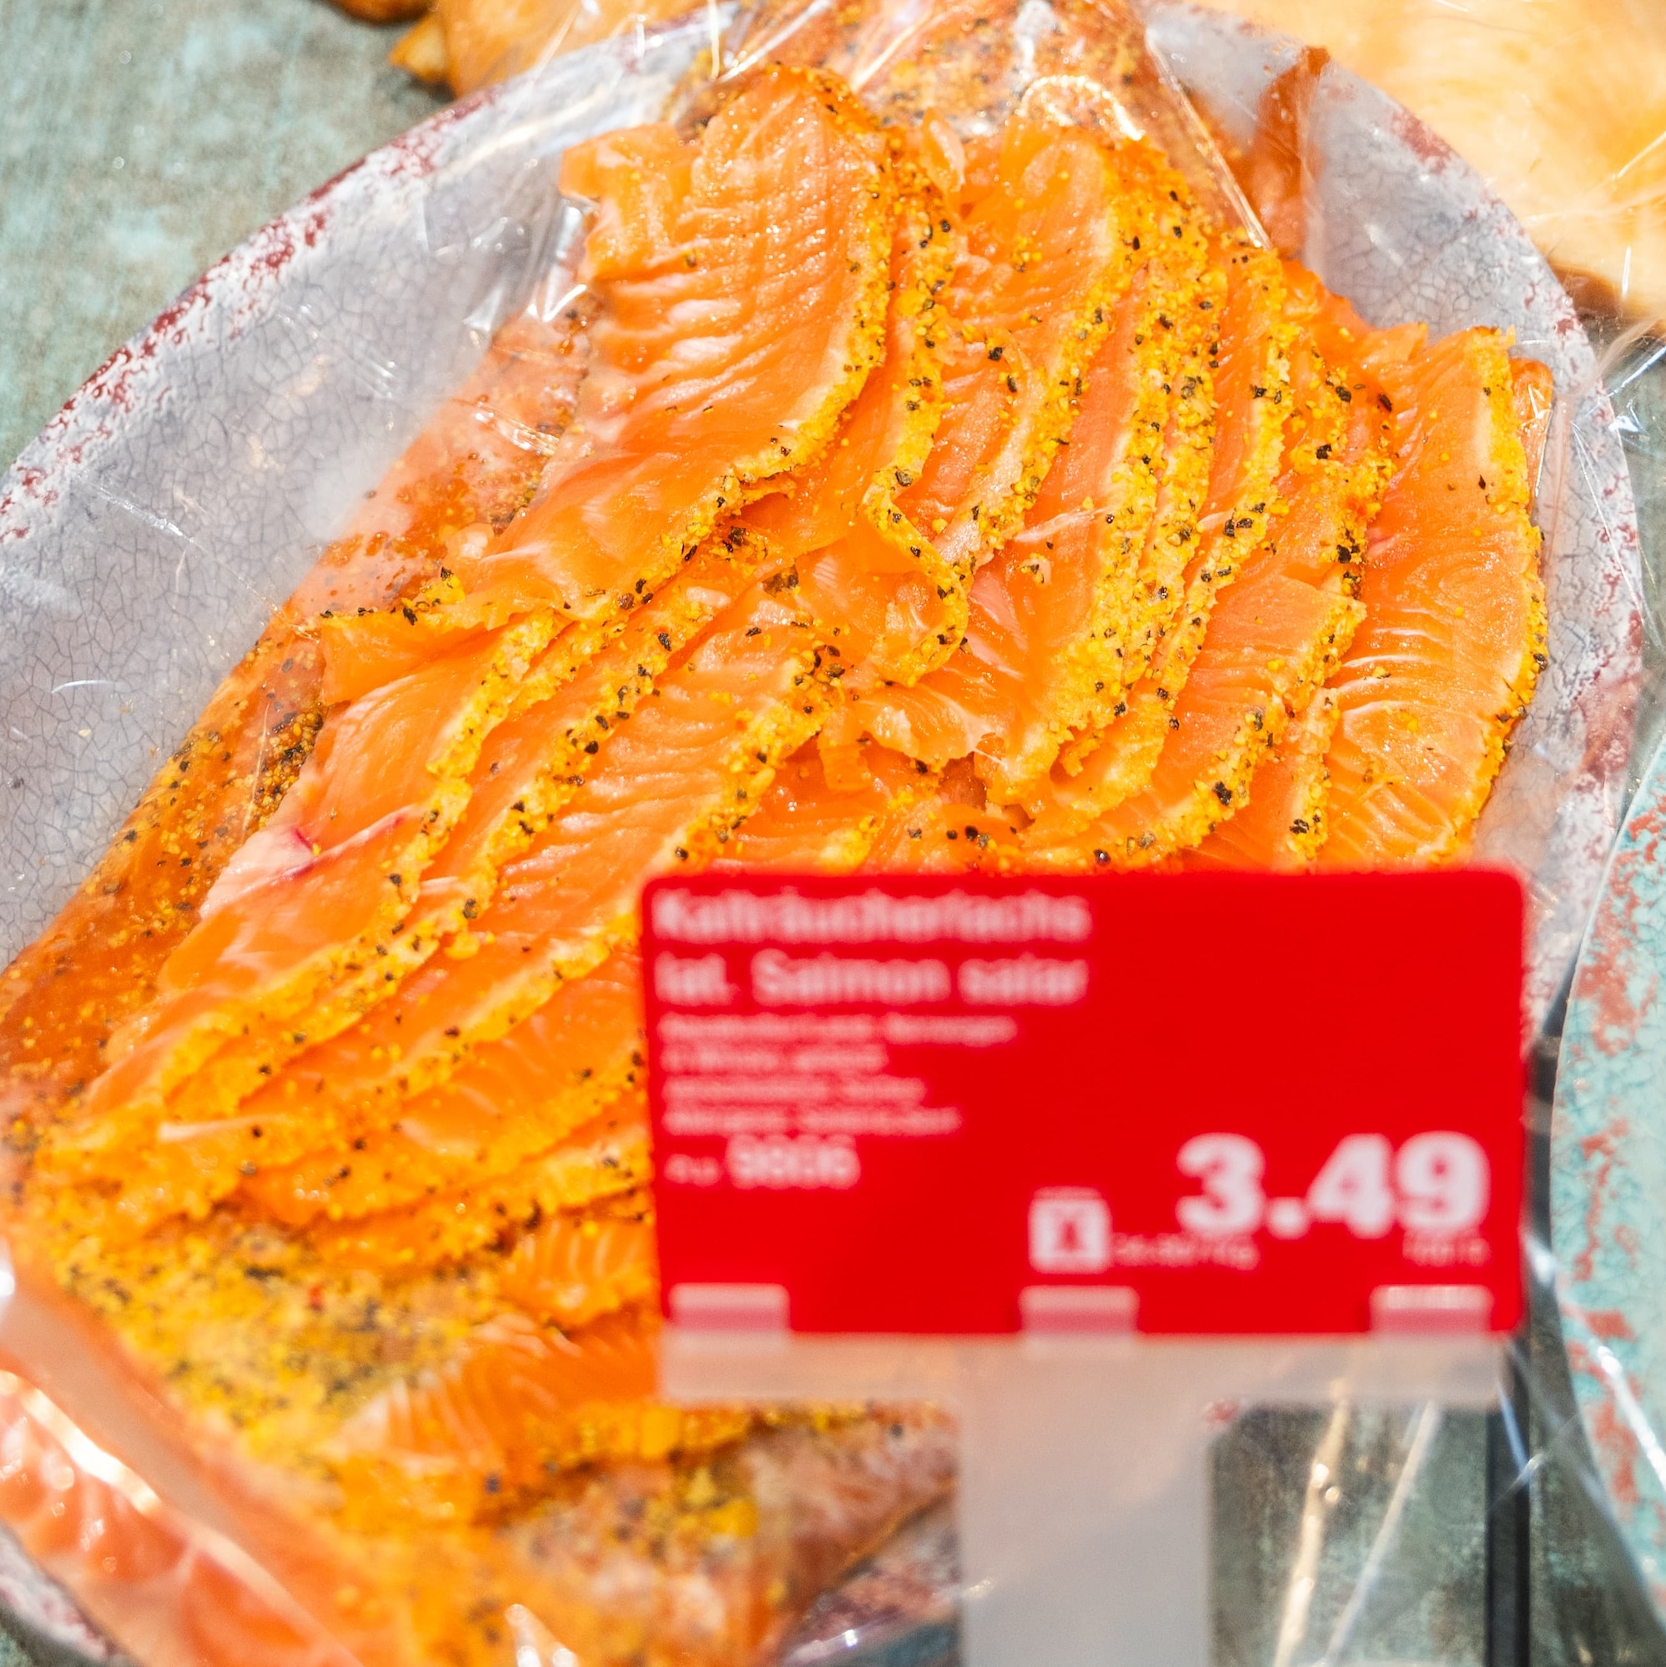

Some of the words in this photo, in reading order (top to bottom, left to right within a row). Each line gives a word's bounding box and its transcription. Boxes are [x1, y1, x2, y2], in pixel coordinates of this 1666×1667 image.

[753, 949, 950, 1004] Salmon
[960, 953, 1088, 1004] salar
[1178, 1131, 1490, 1237] 3.49
